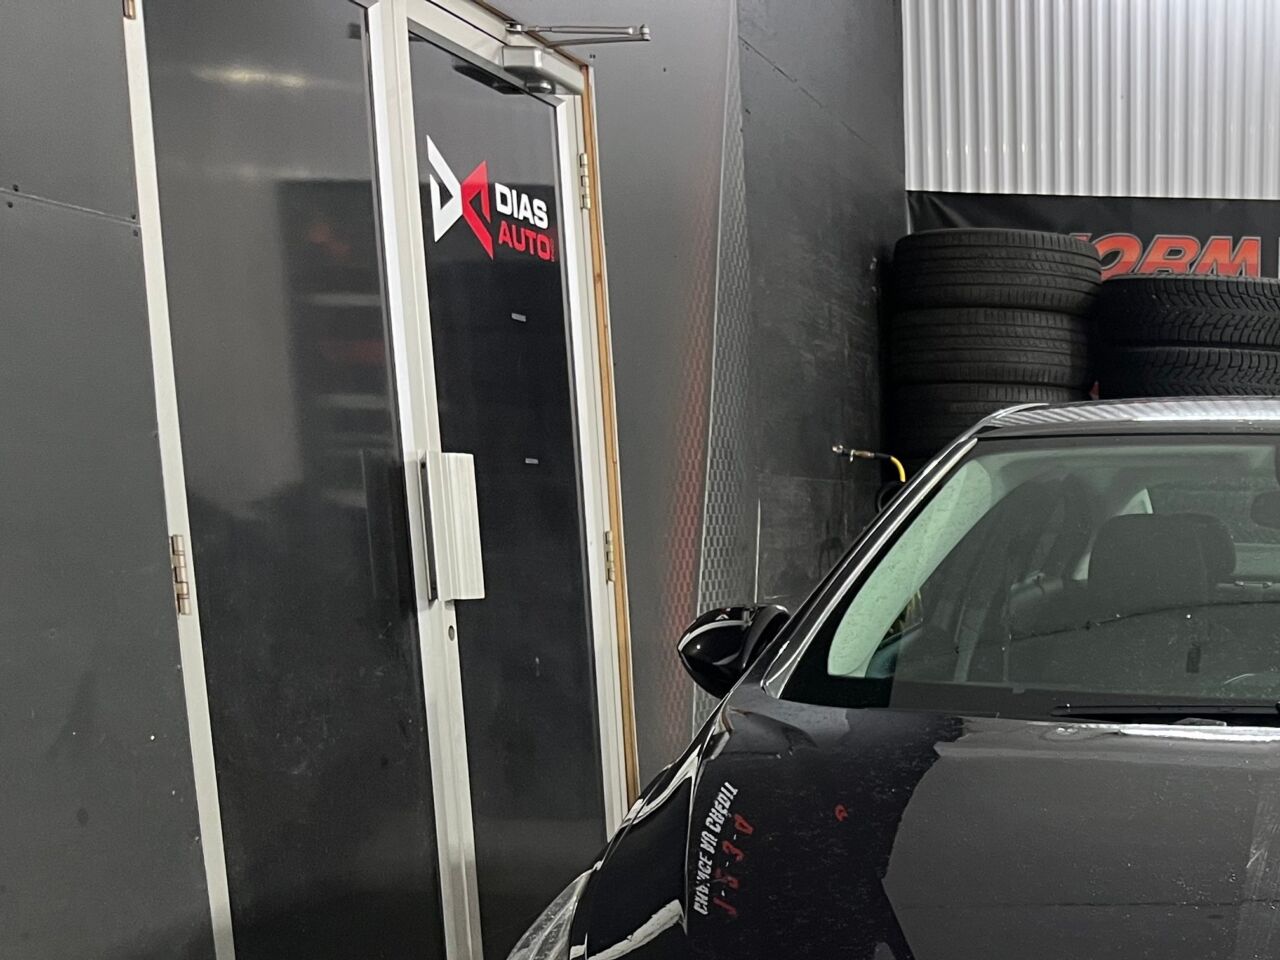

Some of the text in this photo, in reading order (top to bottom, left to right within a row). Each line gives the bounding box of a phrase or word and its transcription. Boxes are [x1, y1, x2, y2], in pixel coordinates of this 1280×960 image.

[495, 182, 548, 229] DIAS
[499, 220, 551, 260] AUTO
[1068, 233, 1261, 283] ORM
